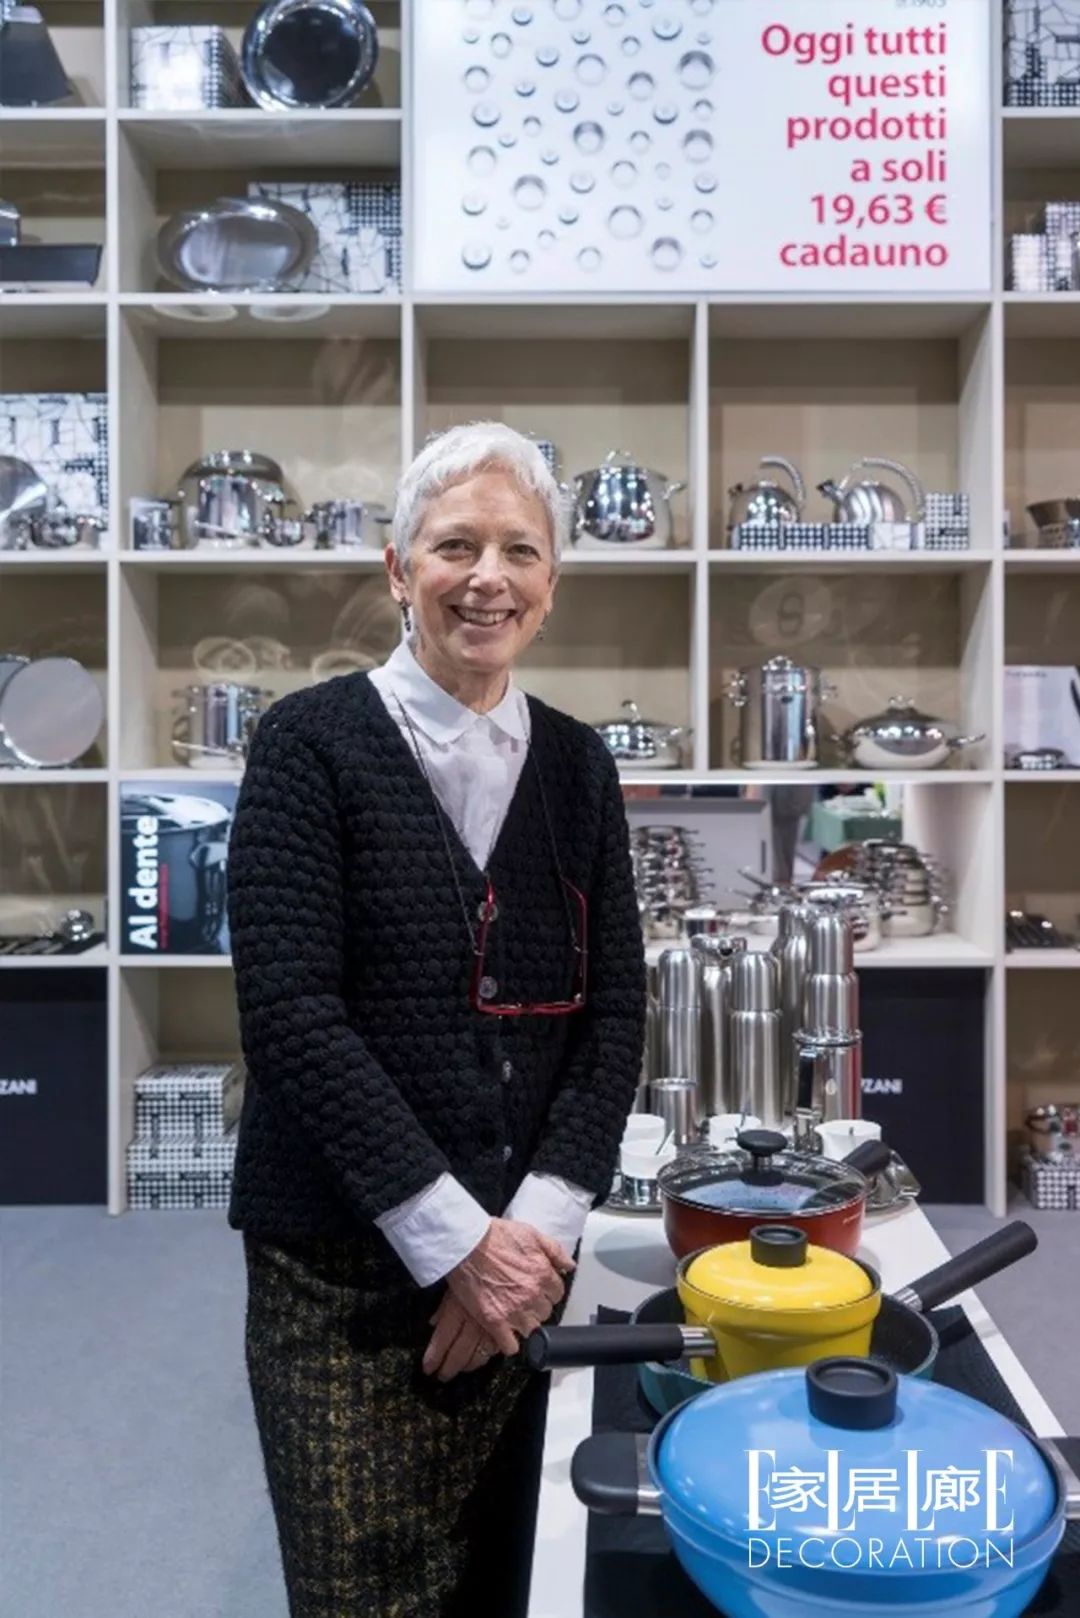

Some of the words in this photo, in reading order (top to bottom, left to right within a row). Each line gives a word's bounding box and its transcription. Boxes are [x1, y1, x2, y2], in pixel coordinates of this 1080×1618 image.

[761, 23, 853, 64] Oggi
[864, 23, 946, 55] tutti
[828, 66, 946, 106] questi
[787, 108, 946, 148] prodotti
[850, 159, 870, 182] a
[882, 150, 946, 182] soli
[811, 194, 914, 229] 19,63
[925, 194, 947, 224] €
[780, 235, 948, 267] cadauno
[128, 816, 158, 908] dente
[128, 916, 158, 949] Al
